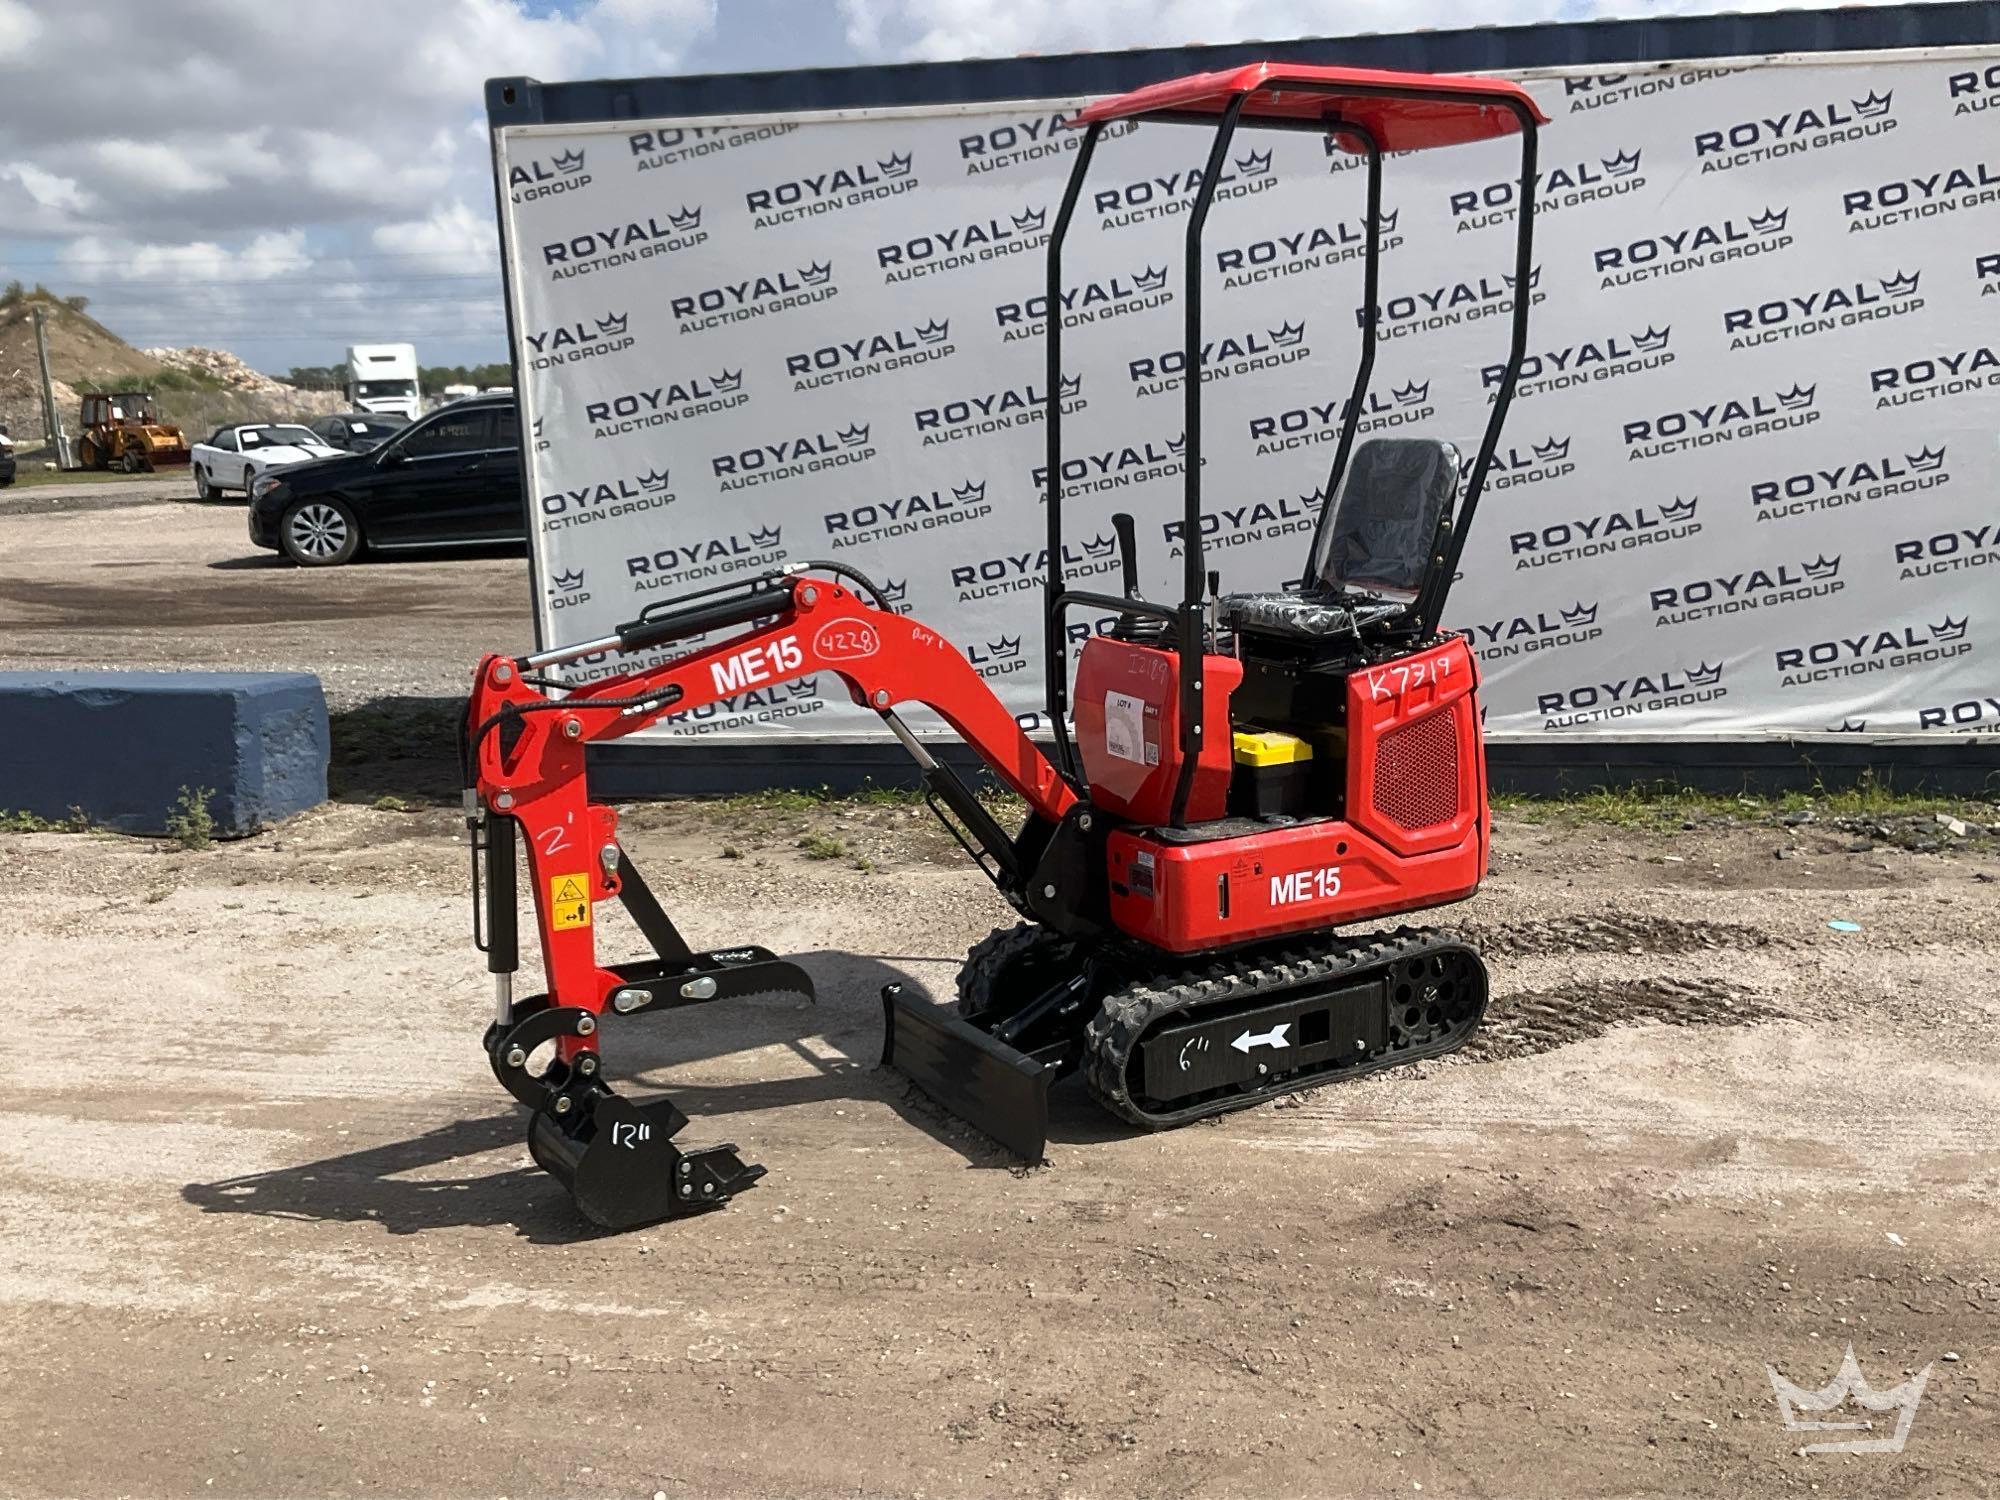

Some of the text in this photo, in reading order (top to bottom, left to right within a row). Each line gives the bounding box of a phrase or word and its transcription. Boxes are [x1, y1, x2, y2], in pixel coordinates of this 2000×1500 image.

[1570, 77, 1675, 113] AUCTION
[959, 113, 1075, 158] ROYA
[1693, 103, 1853, 157] ROYAL
[1699, 118, 1898, 175] AUCTION GROUP
[638, 139, 725, 172] AUCTION
[967, 141, 1060, 175] AUCTION
[524, 176, 591, 202] GROUP
[746, 165, 879, 213] ROYAL
[755, 179, 917, 229] AUCTION GROUP
[1216, 178, 1277, 202] ROUP
[1564, 178, 1645, 207] GROUP
[1847, 198, 1956, 234] AUCTION
[543, 218, 670, 265] ROYAL
[552, 232, 707, 281] AUCTION GROUP
[877, 220, 1012, 268] ROYAL
[1216, 223, 1361, 272] ROYAL
[1594, 221, 1748, 272] ROYAL
[1600, 236, 1792, 289] AUCTION GROUP
[885, 252, 975, 284] AUCTION
[1224, 256, 1320, 289] AUCTION
[670, 273, 799, 319] ROYAL
[679, 287, 837, 334] AUCTION GROUP
[1099, 293, 1172, 319] GROUP
[1376, 293, 1544, 340] UCTION GROP
[1723, 283, 1880, 333] ROYAL
[1729, 298, 1925, 350] AUCTION GROUP
[568, 337, 634, 361] GROUP
[786, 331, 917, 376] ROYAL
[794, 345, 955, 392] AUCTION GROUP
[1234, 348, 1309, 374] GROUP
[1593, 354, 1674, 380] GROUP
[586, 380, 711, 424] ROYAL
[1875, 377, 1983, 409] AUCTION
[595, 394, 748, 439] AUCTION GROUP
[922, 400, 1087, 446] AUCTION GRUP
[1357, 408, 1433, 433] GROUP
[1624, 396, 1776, 444] ROYAL
[1630, 412, 1819, 460] AUCTION GROUP
[711, 434, 839, 477] ROYAL
[719, 448, 876, 492] AUCTION GROUP
[1496, 464, 1574, 489] GROUP
[1751, 458, 1906, 505] ROYAL
[1757, 473, 1950, 521] AUCTION GROUP
[609, 494, 674, 516] GROUP
[824, 491, 953, 534] ROYAL
[832, 506, 991, 549] AUCTION GROUP
[1511, 509, 1658, 554] ROYAL
[1517, 524, 1700, 569] AUCTION GROUP
[1894, 526, 2000, 563] ROY
[627, 536, 751, 577] ROYAL
[635, 550, 787, 591] AUCTION GROUP
[1651, 566, 1801, 610] ROYAL
[1657, 582, 1844, 626] AUCTION GROUP
[821, 630, 873, 652] 4228
[1524, 629, 1601, 652] GROUP
[1776, 627, 1928, 671] ROYAL
[710, 635, 802, 695] ME15
[1368, 657, 1449, 700] K7319
[1781, 643, 1972, 686] AUCTION GROUP
[758, 701, 823, 722] GROUP
[1539, 673, 1684, 714] ROYAL
[1545, 688, 1726, 729] AUCTION GROUP
[1270, 867, 1341, 906] ME15
